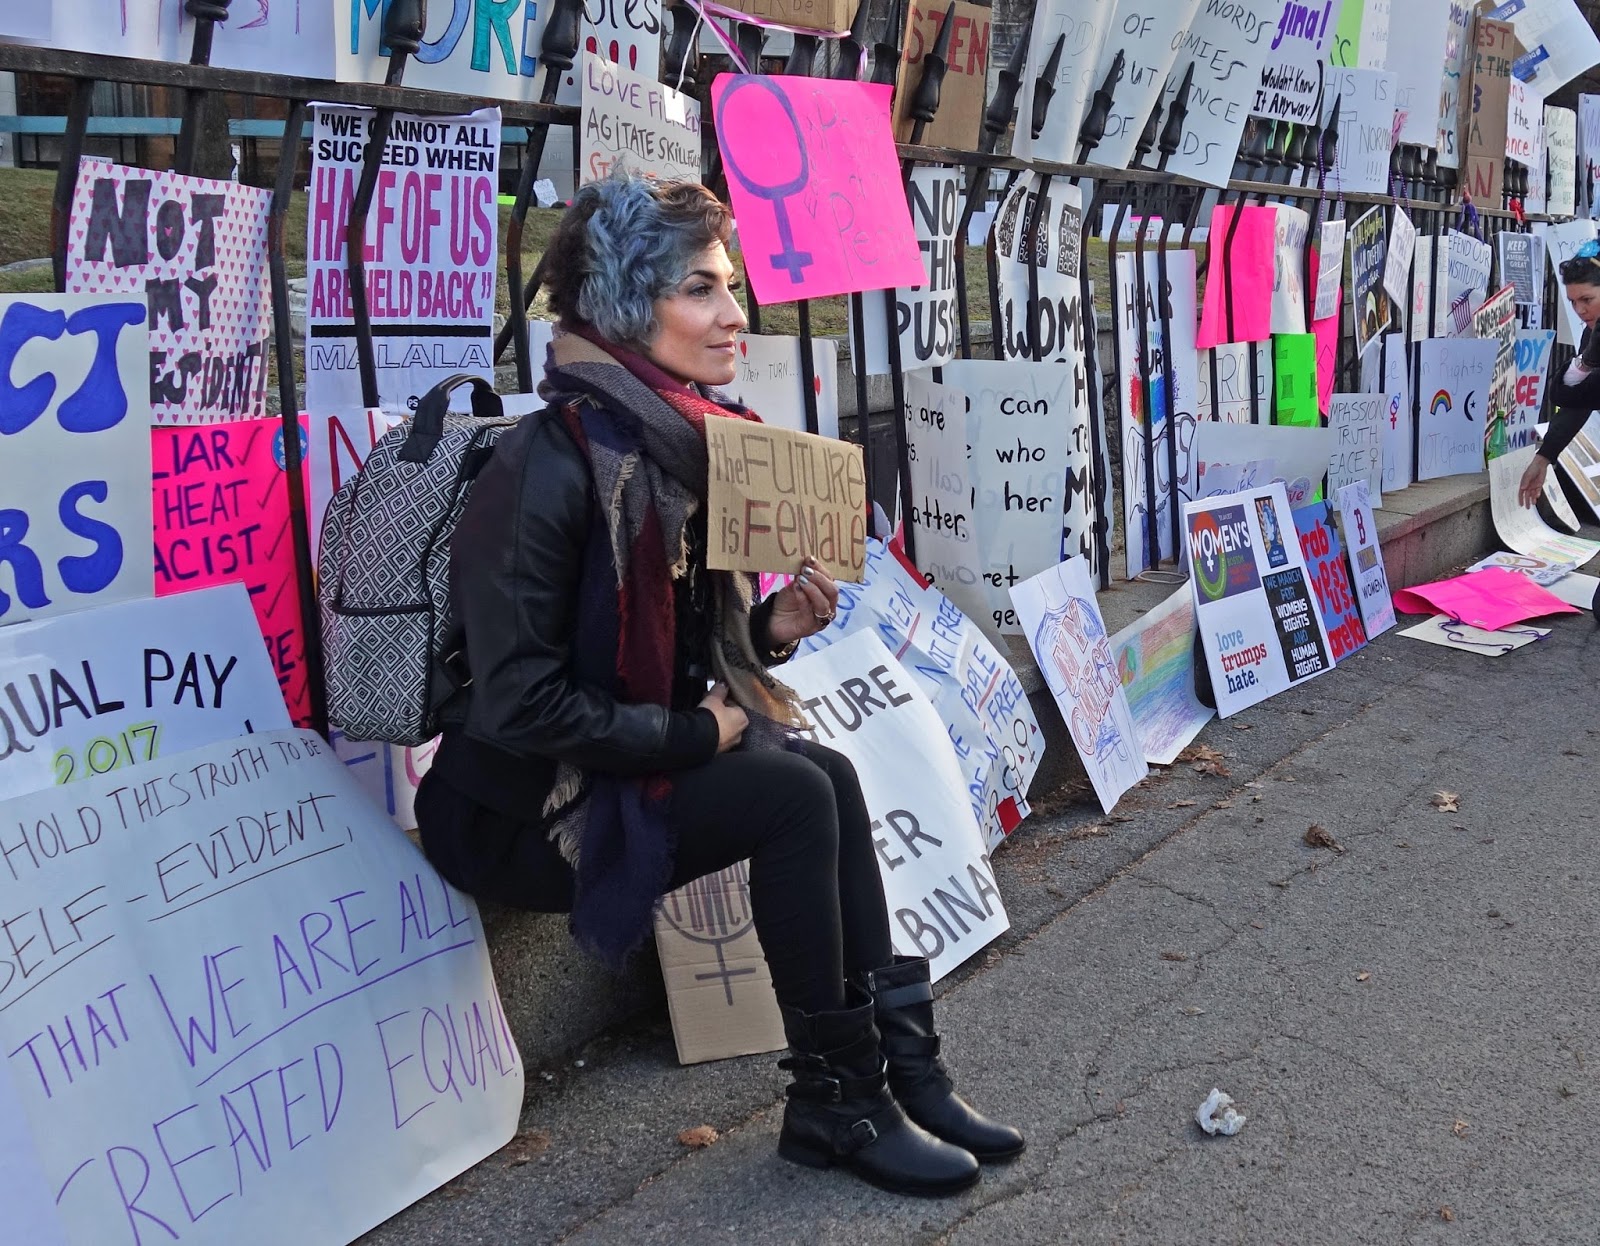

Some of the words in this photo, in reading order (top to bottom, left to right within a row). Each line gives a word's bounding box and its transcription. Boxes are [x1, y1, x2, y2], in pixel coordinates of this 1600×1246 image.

[1124, 13, 1155, 38] OF
[588, 62, 643, 109] LOVE
[455, 125, 495, 148] ALL
[425, 147, 494, 172] WHEN
[84, 179, 226, 269] NOT
[400, 170, 443, 264] OF
[450, 175, 493, 267] US
[1473, 241, 1491, 268] OUR
[1506, 253, 1530, 262] AMERICA
[1507, 240, 1528, 251] KEEP
[1509, 261, 1528, 269] GREAT
[145, 272, 218, 334] MY
[1440, 347, 1484, 395] Rights
[920, 408, 946, 431] are
[1000, 397, 1048, 416] can
[1337, 424, 1379, 446] TRUTH
[711, 433, 744, 484] the
[995, 437, 1046, 463] who
[152, 479, 248, 530] HEAT
[1004, 480, 1052, 513] her
[721, 507, 740, 554] is
[1353, 508, 1367, 545] B
[1189, 520, 1252, 561] WOMEN'S
[1264, 576, 1279, 590] WE
[1277, 570, 1303, 587] MARCH
[1361, 579, 1382, 599] WOMEN
[1280, 586, 1296, 602] FOR
[1275, 598, 1309, 620] WOMENS
[1282, 613, 1311, 634] RIGHTS
[1215, 628, 1245, 652] love
[1293, 630, 1309, 644] AND
[1220, 642, 1268, 673] trumps
[1290, 641, 1318, 663] HUMAN
[143, 647, 238, 710] PAY
[1294, 657, 1323, 678] RIGHTS
[1226, 668, 1260, 695] hate.
[54, 724, 159, 784] 2017
[107, 776, 192, 832] THIS
[190, 746, 267, 800] TRUTH
[271, 741, 301, 765] TO
[300, 737, 322, 757] BE
[8, 982, 130, 1099] THAT
[149, 945, 252, 1067] WE
[273, 890, 381, 1009] ARE
[400, 872, 471, 954] ALL
